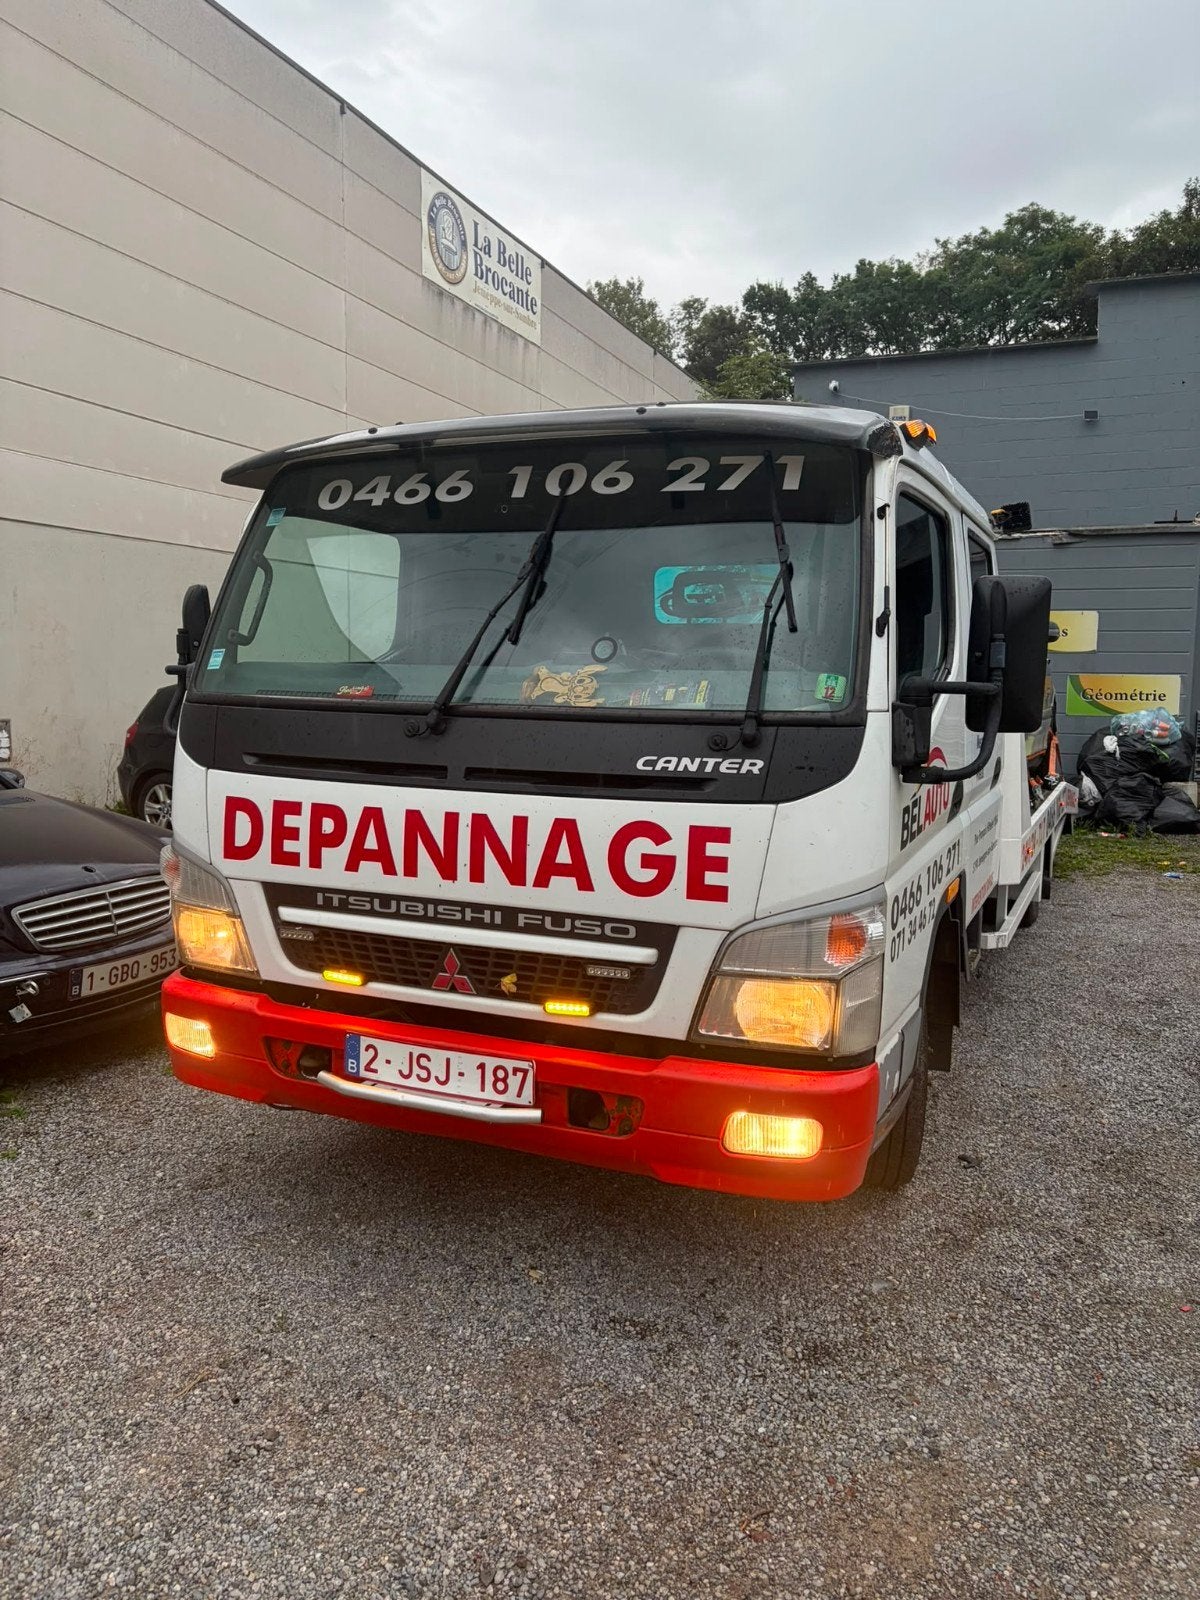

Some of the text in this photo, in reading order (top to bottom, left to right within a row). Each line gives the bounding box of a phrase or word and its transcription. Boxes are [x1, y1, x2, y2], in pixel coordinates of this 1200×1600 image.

[473, 219, 492, 258] La
[497, 236, 532, 286] Belle
[473, 249, 537, 316] Brocante
[317, 455, 805, 511] 0466 106 271
[1081, 687, 1167, 702] Géométrie
[636, 755, 764, 775] CANTER
[223, 795, 732, 903] DEPANNAGE
[891, 874, 922, 931] 0466
[927, 854, 943, 896] 106
[946, 838, 960, 877] 271
[316, 892, 637, 939] ITSUBISHI FUSO
[890, 927, 905, 963] 071
[908, 915, 917, 946] 34
[72, 985, 80, 996] B
[348, 1043, 530, 1098] B 2-JSJ-187
